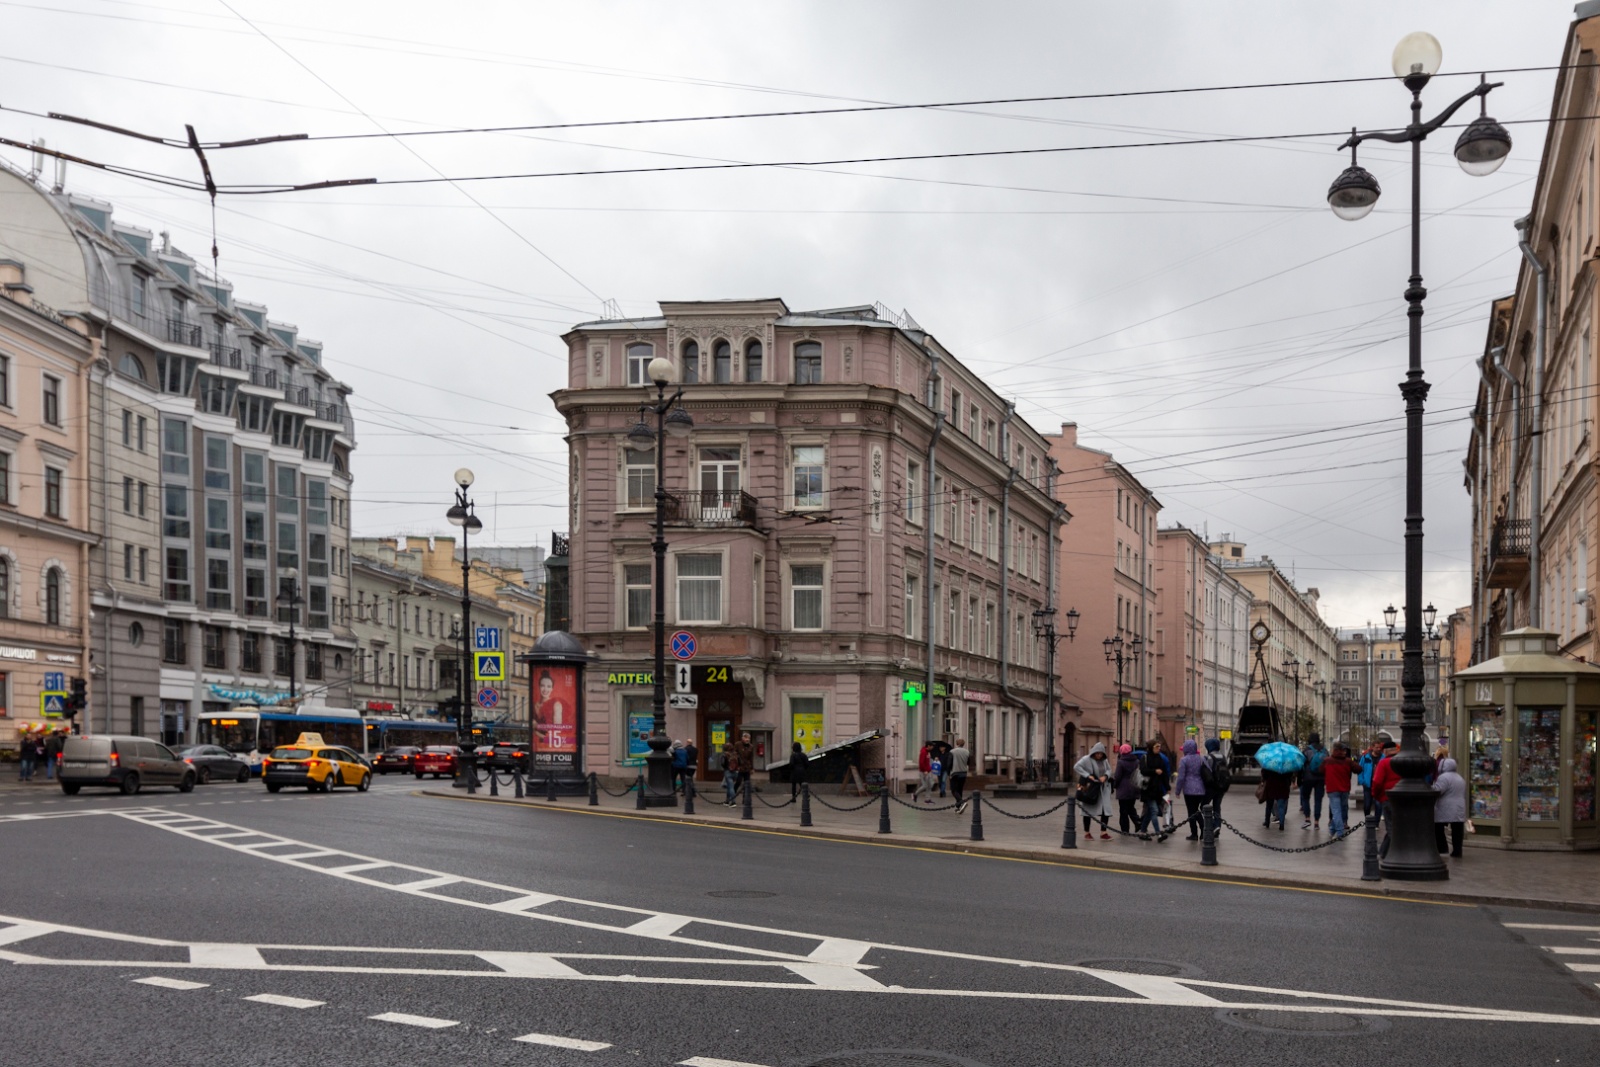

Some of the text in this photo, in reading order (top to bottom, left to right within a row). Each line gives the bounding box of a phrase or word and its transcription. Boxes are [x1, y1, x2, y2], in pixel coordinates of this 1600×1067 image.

[608, 673, 655, 684] АПТЕК
[706, 667, 728, 682] 24
[535, 754, 573, 762] РИВ ГОШ
